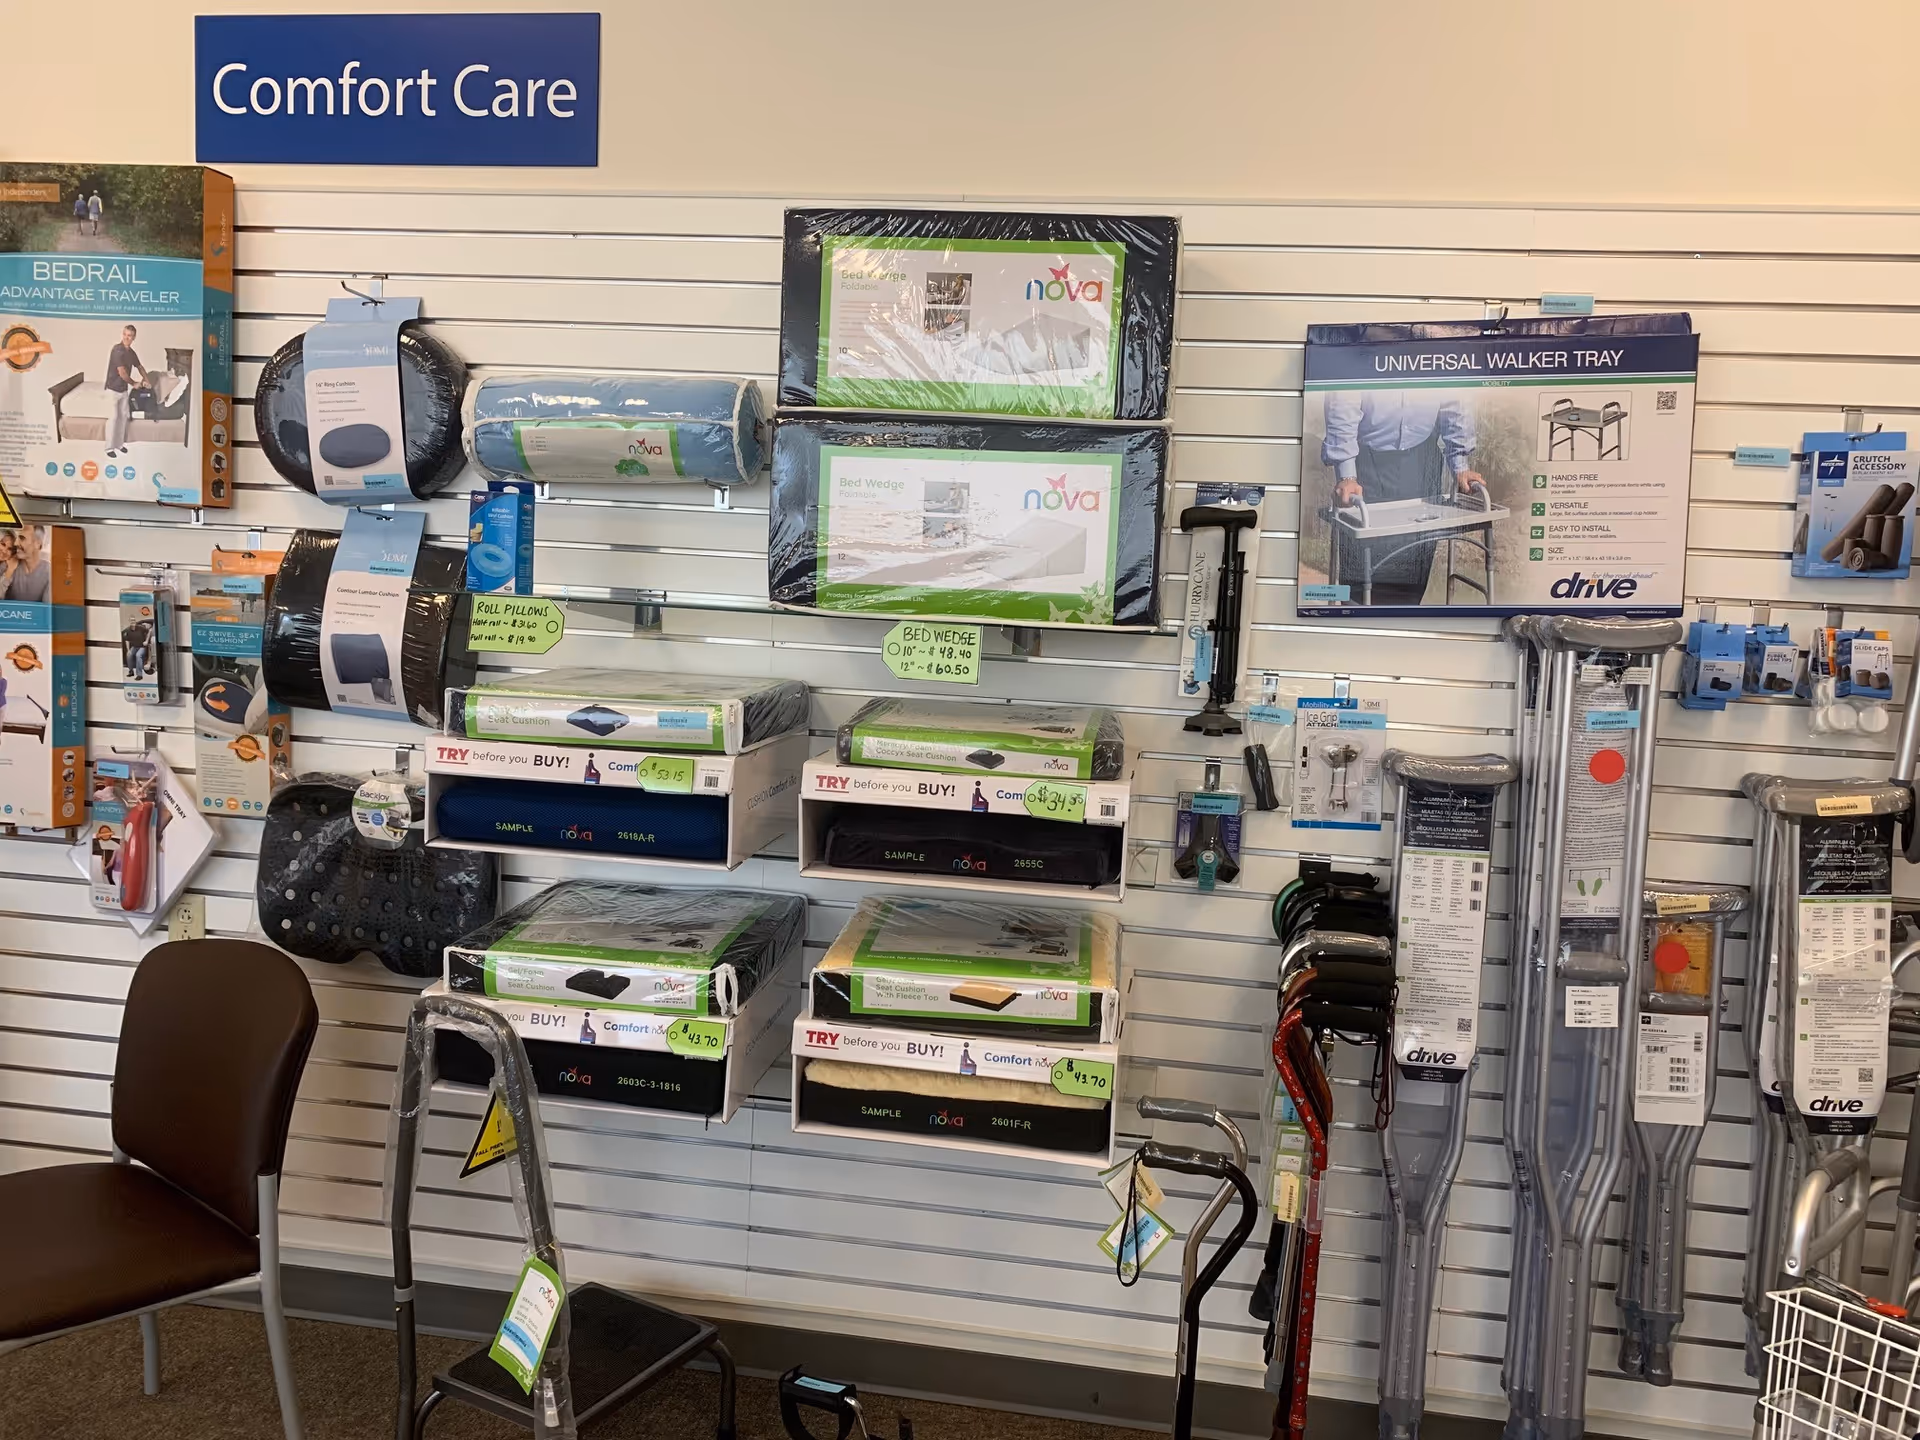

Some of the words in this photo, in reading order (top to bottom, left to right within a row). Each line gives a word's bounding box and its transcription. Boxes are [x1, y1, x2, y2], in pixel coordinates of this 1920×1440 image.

[213, 61, 437, 116] Comfort
[453, 64, 577, 117] Care
[33, 261, 148, 284] BEDRAIL
[841, 269, 864, 281] Bed
[1, 286, 95, 301] ADVANTAGE
[101, 290, 180, 304] TRAVELER
[1026, 276, 1103, 302] nova
[1374, 353, 1482, 372] UNIVERSAL
[1486, 351, 1568, 370] WALKER
[1573, 350, 1625, 368] TRAY
[629, 443, 662, 455] nova
[1853, 455, 1891, 463] CRUTCH
[1852, 463, 1907, 471] ACCESSORY
[1579, 473, 1599, 481] FREE
[839, 477, 862, 489] Bed
[864, 478, 905, 491] Wedge
[1023, 487, 1100, 513] nova
[1531, 529, 1543, 537] EZ
[336, 587, 358, 595] Contour
[359, 588, 378, 596] Lumbar
[1190, 551, 1206, 622] HURRYCANE
[1550, 572, 1638, 599] drive
[476, 601, 500, 614] ROLL
[504, 604, 549, 617] PILLOWS
[472, 619, 488, 627] Half
[208, 630, 236, 638] SWIVEL
[903, 626, 931, 642] BED
[933, 629, 977, 646] WEDGE
[1302, 701, 1330, 710] Mobility
[488, 714, 509, 724] Seat
[512, 716, 550, 726] Cushion
[1306, 712, 1319, 722] Ice
[1320, 712, 1338, 723] Grip
[909, 743, 934, 751] Foam
[436, 747, 470, 761] TRY
[472, 751, 506, 763] before
[508, 754, 528, 766] you
[533, 754, 570, 769] BUY!
[875, 748, 904, 758] Coccyx
[906, 750, 923, 758] Seat
[926, 753, 957, 762] Cushion
[608, 761, 638, 772] Comf
[1044, 762, 1069, 771] nova
[815, 775, 850, 790] TRY
[853, 779, 889, 792] before
[891, 782, 912, 794] you
[917, 783, 956, 798] BUY!
[95, 805, 123, 815] HANDY
[163, 789, 176, 809] OMNI
[173, 804, 187, 820] TRAY
[495, 822, 533, 833] SAMPLE
[560, 829, 592, 842] nova
[617, 831, 655, 844] 2618A-R
[884, 850, 925, 862] SAMPLE
[953, 858, 987, 872] nova
[1014, 858, 1044, 869] 2655C
[507, 981, 524, 990] Seat
[526, 983, 555, 992] Cushion
[654, 982, 685, 993] nova
[875, 984, 892, 992] Seat
[895, 985, 926, 993] Cushion
[896, 992, 922, 1001] Fleece
[923, 994, 939, 1002] Top
[1035, 990, 1068, 1001] nova
[507, 1013, 525, 1022] you
[530, 1013, 566, 1028] BUY!
[603, 1021, 649, 1034] Comfort
[651, 1026, 667, 1036] nov
[806, 1030, 840, 1046] TRY
[843, 1035, 878, 1048] before
[881, 1040, 901, 1052] you
[906, 1042, 944, 1058] BUY!
[984, 1051, 1032, 1067] Comfort
[1406, 1047, 1457, 1065] drive
[559, 1072, 592, 1086] nova
[617, 1076, 681, 1092] 2603C-3-1816
[1809, 1095, 1863, 1113] drive
[861, 1105, 902, 1119] SAMPLE
[929, 1115, 964, 1128] nova
[991, 1117, 1032, 1130] 2601F-R
[475, 1149, 489, 1157] FALL
[539, 1286, 556, 1309] nova
